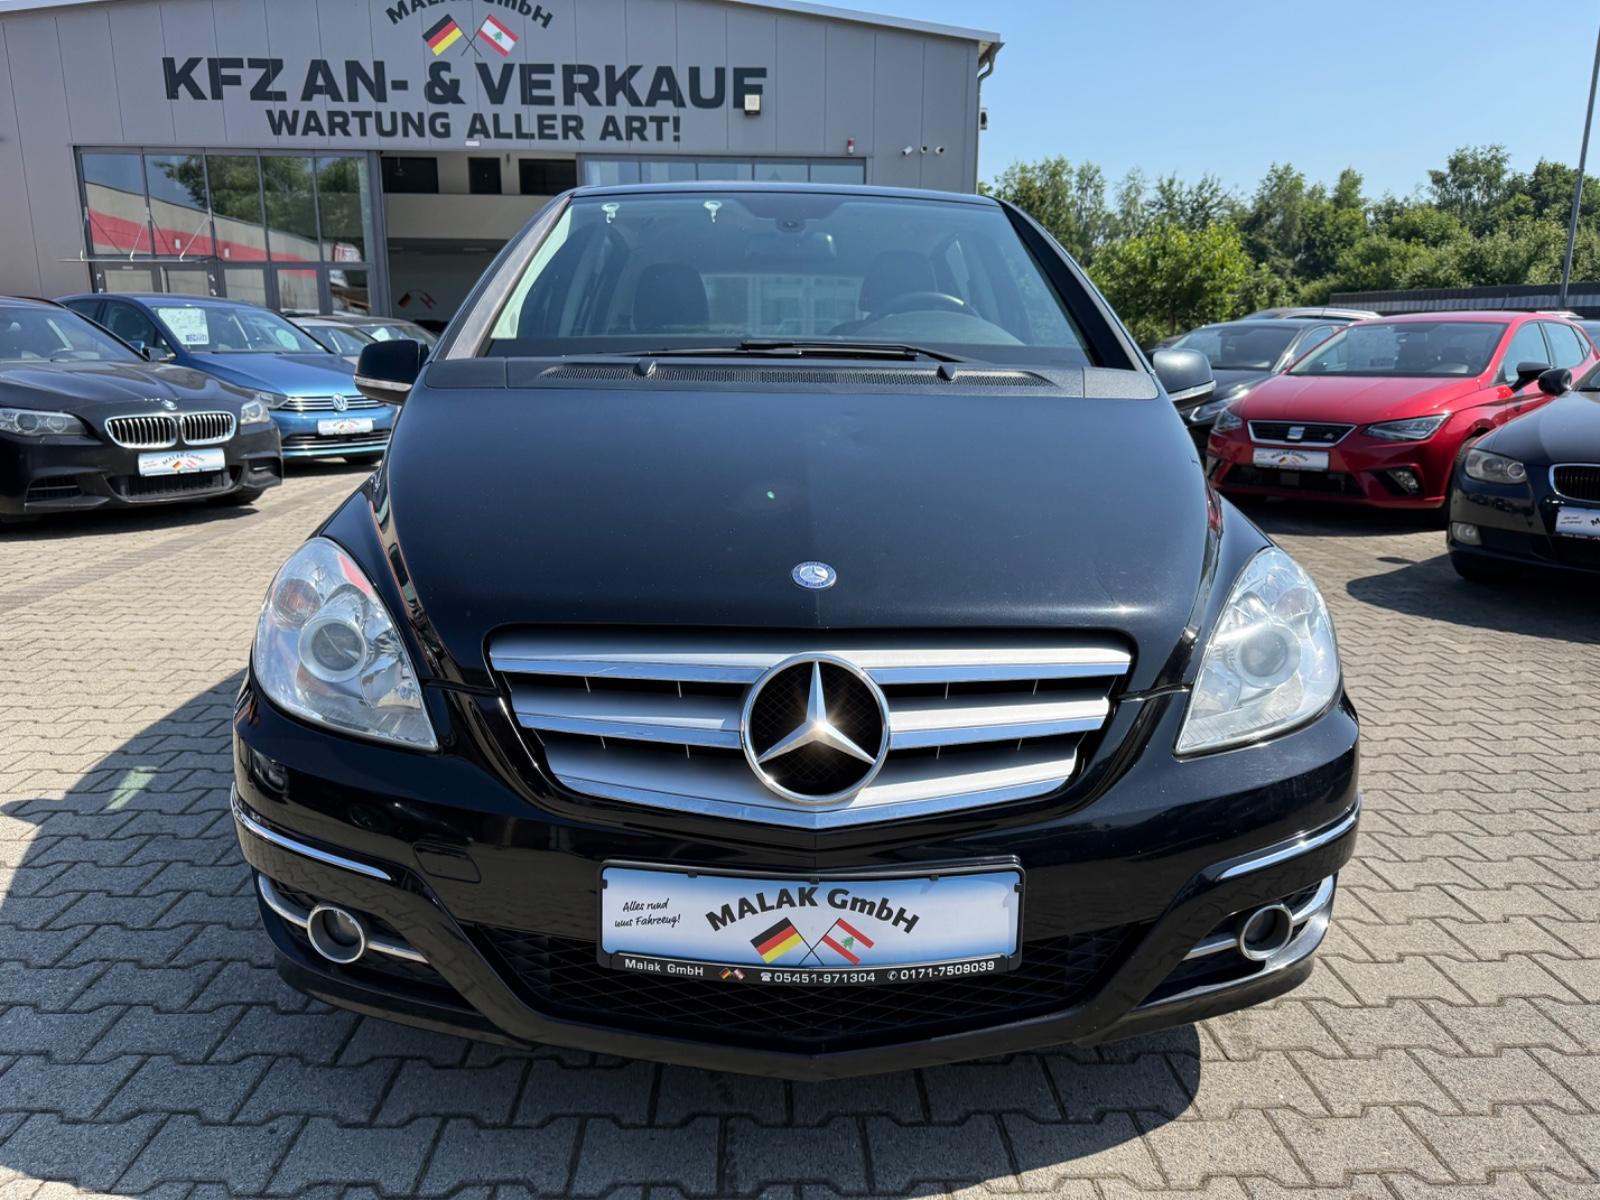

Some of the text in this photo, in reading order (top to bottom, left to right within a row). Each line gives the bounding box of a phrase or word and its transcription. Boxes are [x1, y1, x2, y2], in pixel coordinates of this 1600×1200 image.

[482, 0, 553, 29] mbH
[162, 57, 768, 109] KFZ AN- & VERKAUF
[265, 109, 681, 142] WARTUNG ALLER ART!
[622, 897, 670, 912] Alles rund
[705, 886, 920, 934] MALAK GmbH
[636, 913, 681, 928] Fahrzeug!
[624, 958, 661, 972] Malak
[667, 963, 704, 976] GmbH
